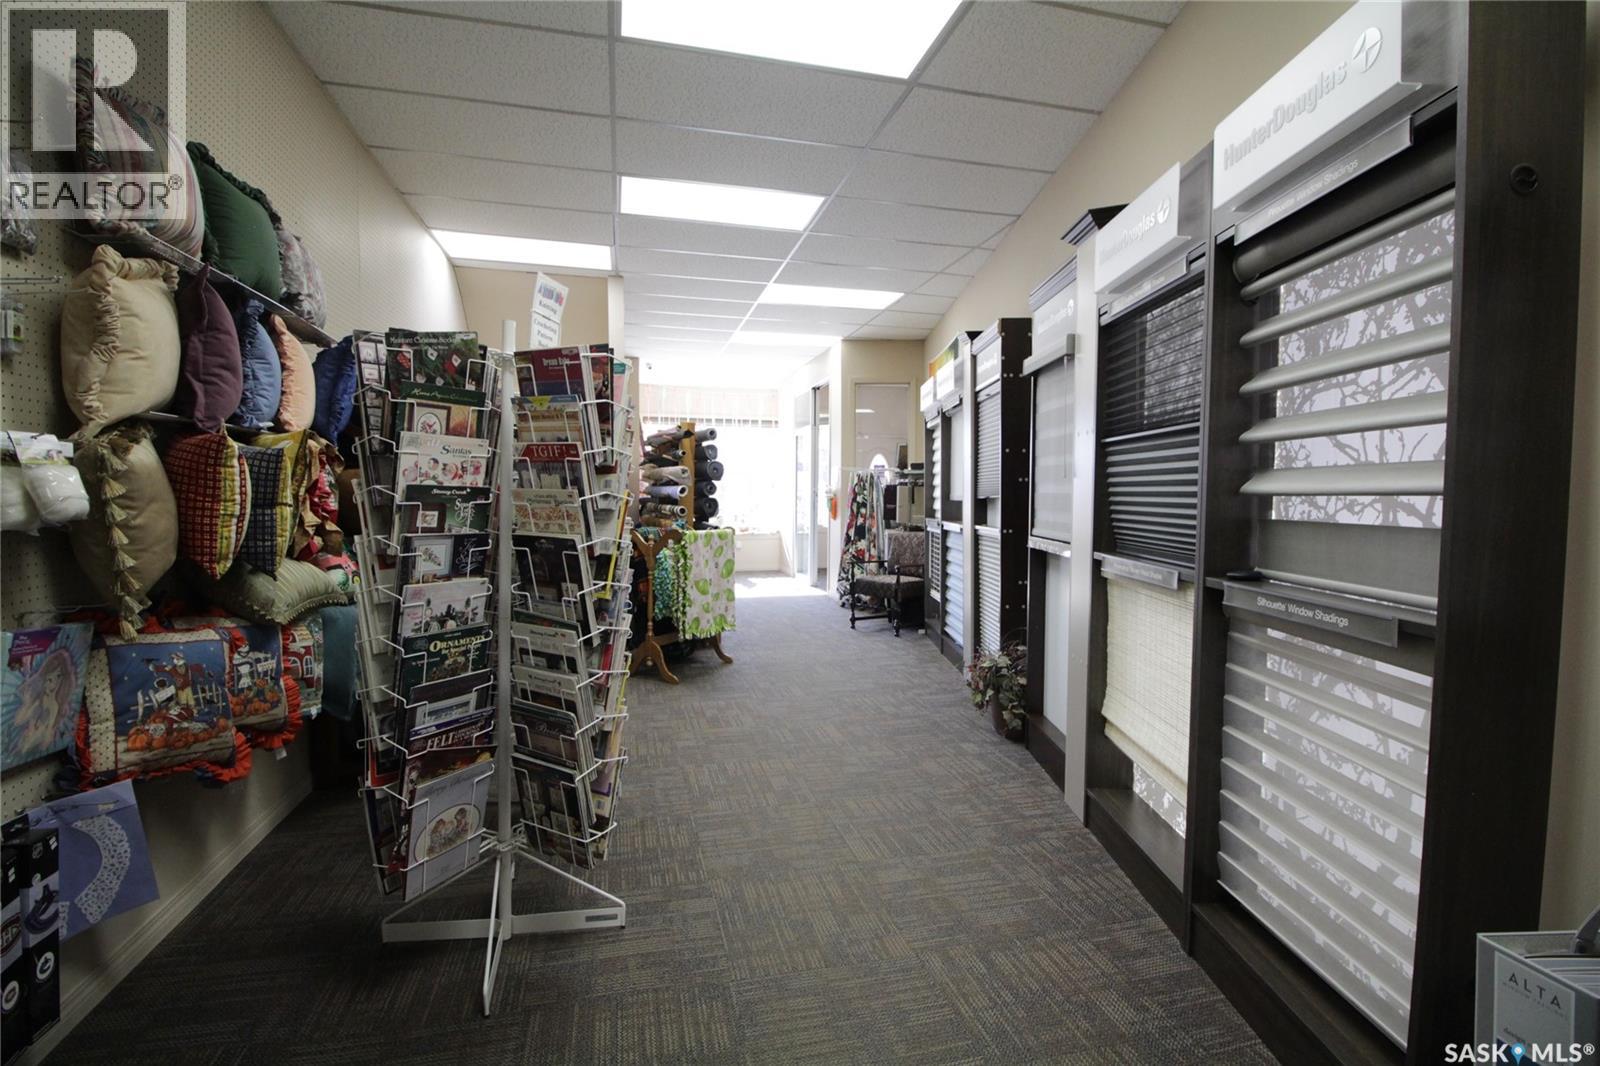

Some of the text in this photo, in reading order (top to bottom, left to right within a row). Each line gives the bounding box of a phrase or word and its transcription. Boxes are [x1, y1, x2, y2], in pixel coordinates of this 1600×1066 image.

[440, 444, 472, 456] Santas
[530, 445, 567, 458] TGIF!
[1287, 603, 1313, 619] Window
[1314, 608, 1350, 628] Shadings
[427, 732, 455, 750] FELT
[1508, 972, 1562, 1010] ALTA
